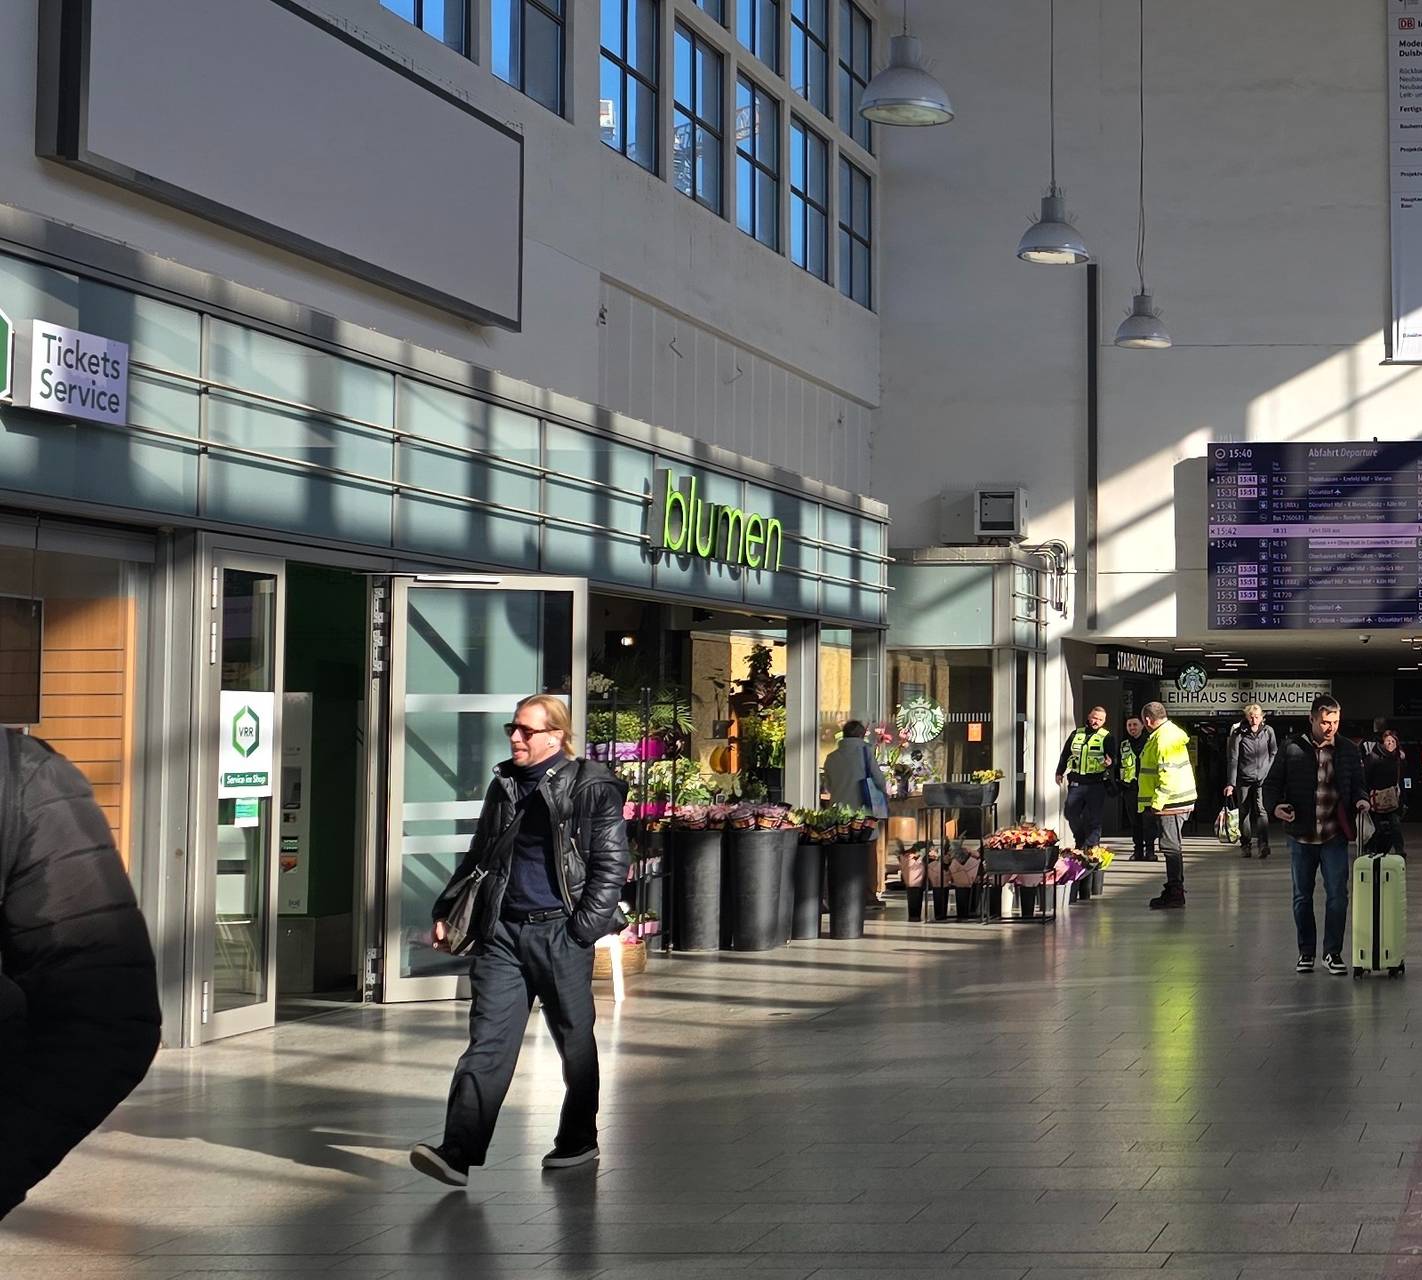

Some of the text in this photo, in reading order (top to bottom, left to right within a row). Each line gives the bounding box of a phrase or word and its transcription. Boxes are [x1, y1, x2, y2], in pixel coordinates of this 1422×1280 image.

[42, 333, 120, 380] Tickets
[40, 368, 120, 413] Service
[1229, 448, 1253, 458] 15:40
[1309, 448, 1339, 457] Abfahrt
[1340, 448, 1378, 459] Departure
[1216, 475, 1237, 485] 15:01
[1216, 501, 1237, 510] 15:41
[661, 468, 782, 572] blumen
[1216, 514, 1237, 522] 15:42
[1217, 527, 1237, 536] 15:42
[1217, 540, 1237, 549] 15:44
[1216, 565, 1237, 574] 15:47
[1216, 591, 1237, 600] 15:51
[1216, 604, 1237, 613] 15:53
[1216, 616, 1237, 625] 15:55
[1161, 691, 1227, 703] LEIHHAUS
[239, 727, 254, 737] VRR
